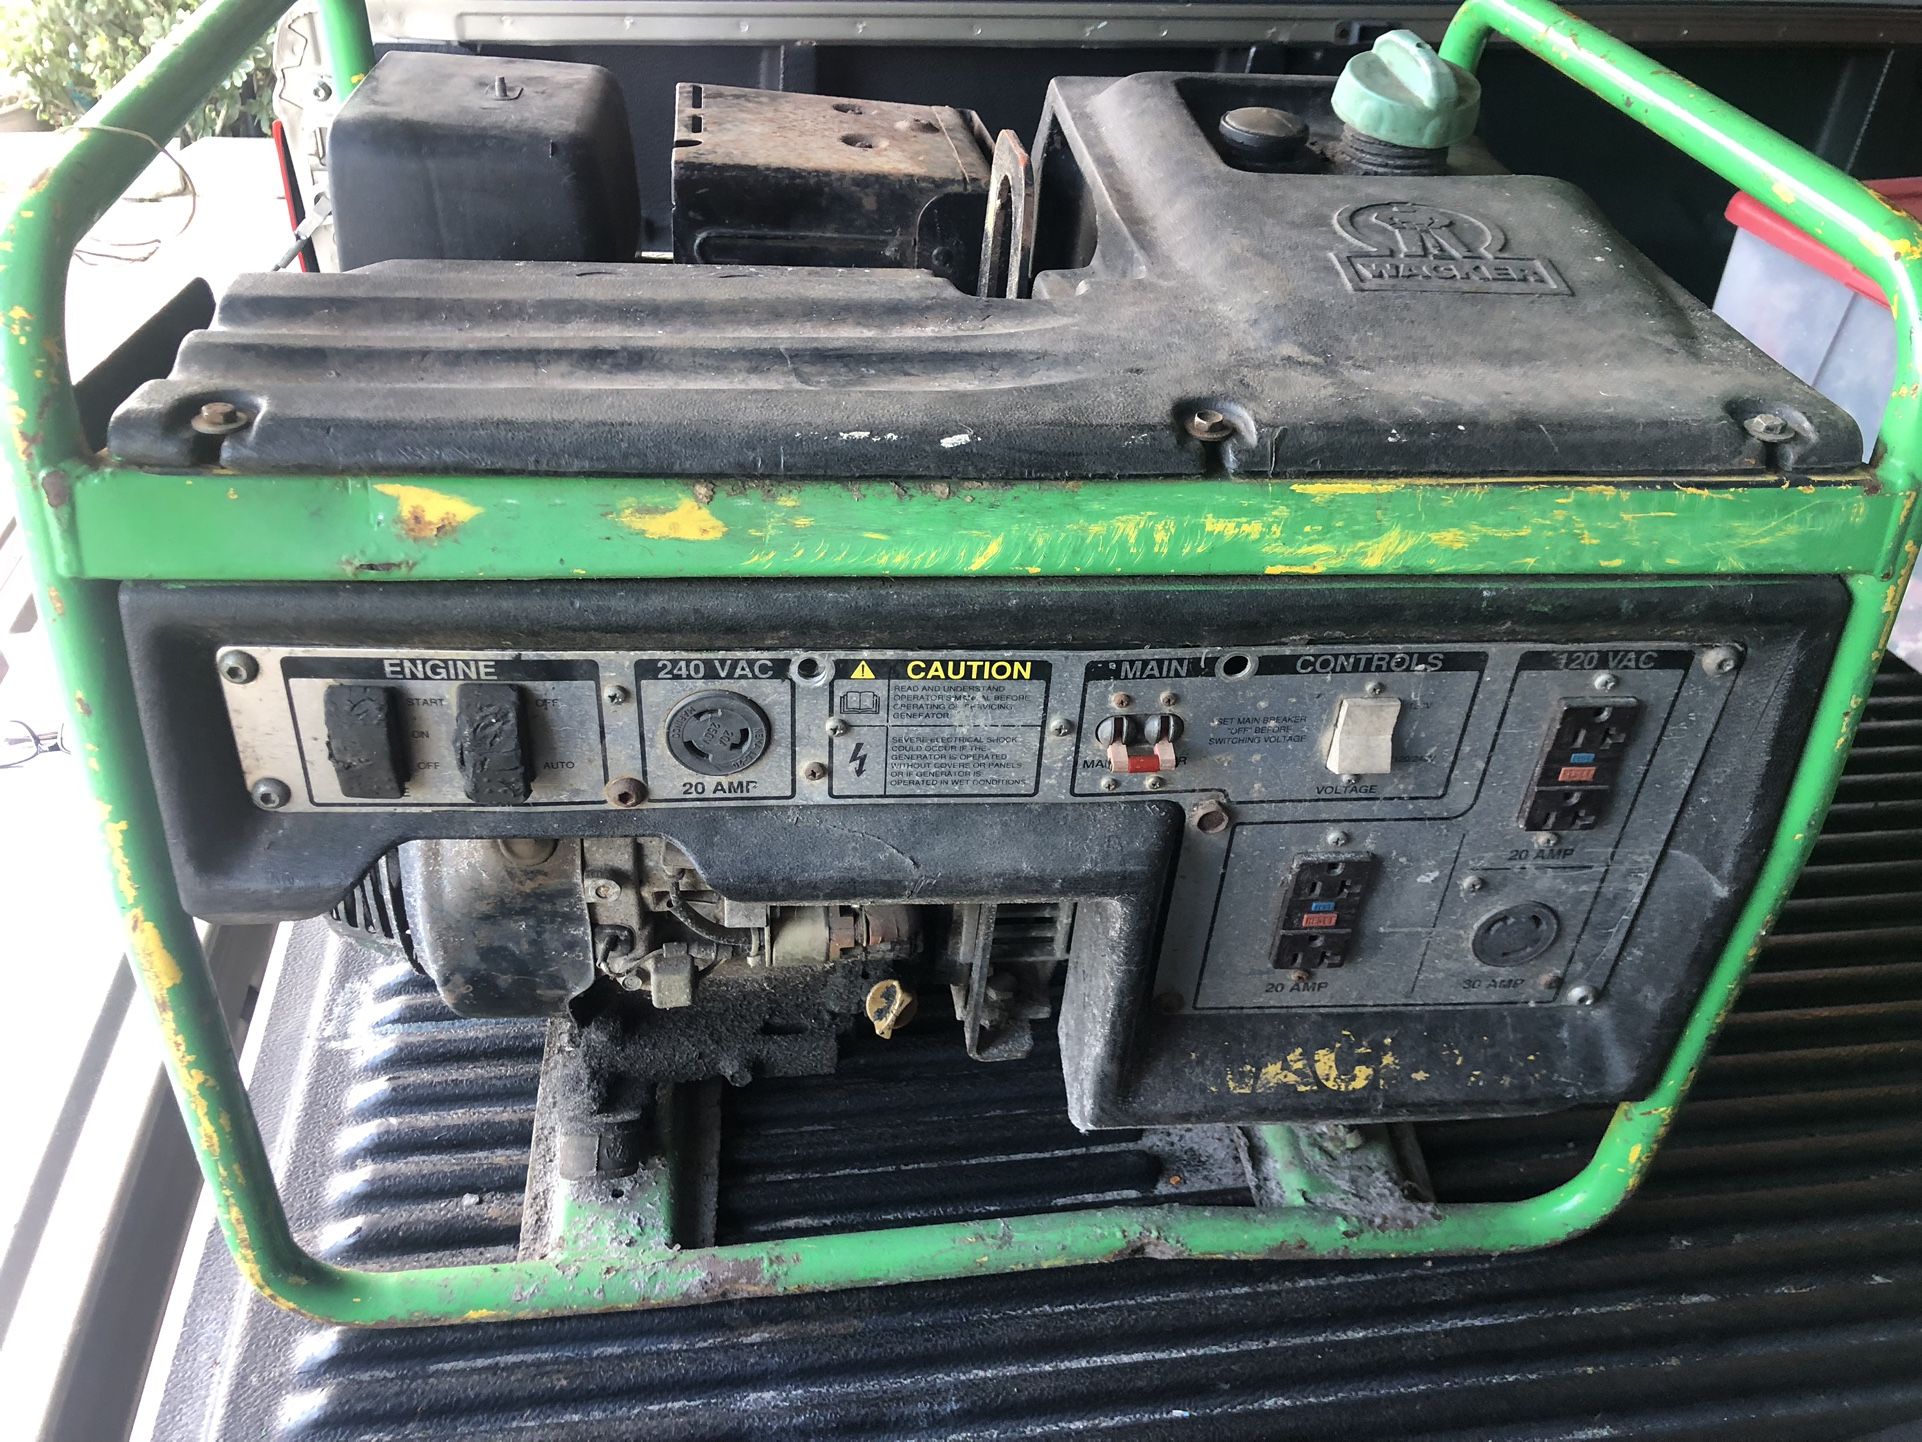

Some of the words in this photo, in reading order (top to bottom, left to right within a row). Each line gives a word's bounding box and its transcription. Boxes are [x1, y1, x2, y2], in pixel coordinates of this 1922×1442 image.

[1356, 263, 1549, 284] WACKER
[1120, 661, 1188, 679] MAIN
[1296, 653, 1444, 673] CONTROLS
[1557, 652, 1599, 669] 120
[1608, 652, 1658, 668] VAC
[384, 660, 498, 680] ENGINE
[657, 660, 705, 678] 240
[714, 660, 774, 678] VAC
[907, 661, 1032, 680] CAUTION
[407, 698, 445, 707] START
[535, 698, 558, 708] OFF
[1217, 717, 1234, 725] SET
[1237, 717, 1260, 725] MAIN
[1262, 716, 1307, 724] BREAKER
[412, 730, 430, 740] ON
[1254, 726, 1292, 734] BEFORE
[1208, 736, 1261, 745] SWITCHING
[1263, 735, 1307, 744] VOLTAGE
[417, 762, 440, 770] OFF
[543, 761, 575, 770] AUTO
[1082, 759, 1111, 769] MAI
[682, 782, 706, 795] 20
[712, 781, 758, 794] AMP
[1315, 785, 1378, 795] VOLTAGE
[1507, 849, 1530, 861] 20
[1532, 848, 1576, 860] AMP
[1265, 982, 1287, 993] 20
[1289, 981, 1328, 993] AMP
[1462, 978, 1483, 990] 30
[1488, 978, 1525, 990] AMP
